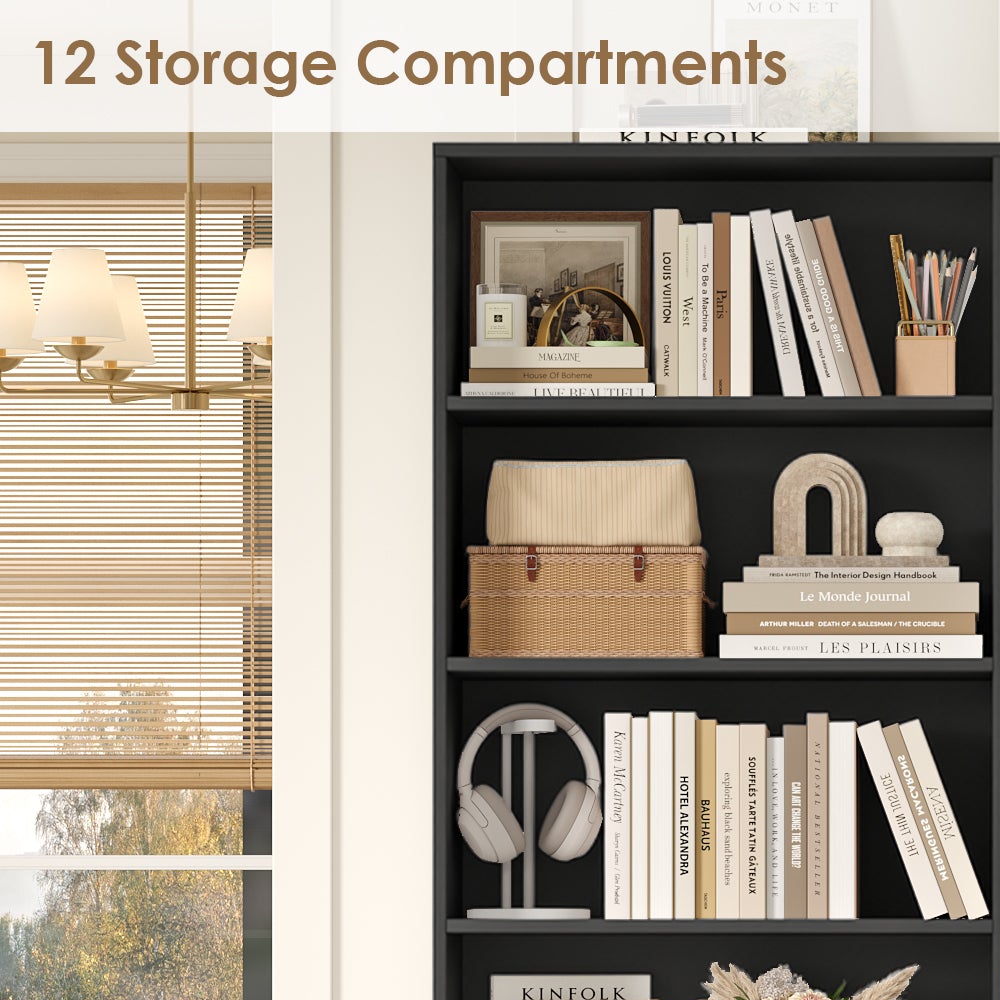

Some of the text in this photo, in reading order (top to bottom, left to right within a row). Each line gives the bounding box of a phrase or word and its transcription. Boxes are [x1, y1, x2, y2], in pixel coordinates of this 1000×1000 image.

[746, 1, 842, 14] MONET
[702, 263, 709, 273] To
[702, 275, 709, 287] Be
[663, 252, 671, 324] LOUIS VUITTON
[682, 297, 693, 326] West
[716, 289, 728, 320] Paris
[538, 352, 582, 362] MAGAZINE
[523, 371, 593, 379] House Of Boheme
[814, 571, 937, 581] The Interior Design Handbook
[800, 591, 911, 604] Le Monde Journal
[820, 641, 942, 654] LES PLAISIRS
[609, 731, 626, 824] Karen McCartney
[721, 772, 733, 834] exploring black
[680, 776, 689, 876] HOTEL ALEXANDRA
[701, 799, 710, 851] BAUHAUS
[748, 756, 758, 895] SOUFFLÉS TARTE TATIN GÂTEAUX
[791, 781, 802, 869] CAN ART CHANGE THE WORLD?
[814, 741, 822, 896] NATIONAL BESTSELLER
[522, 987, 627, 1000] KINFOLK
